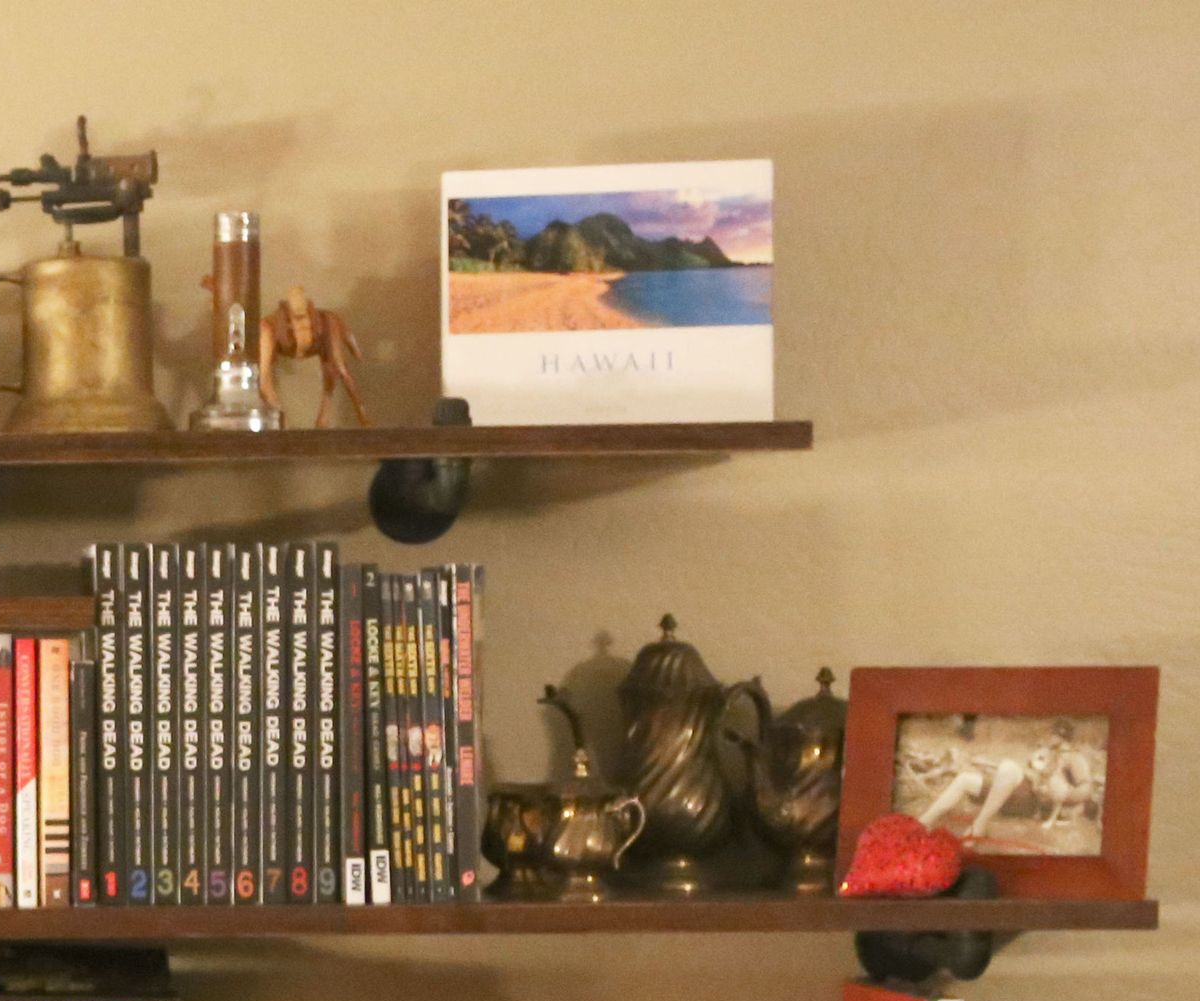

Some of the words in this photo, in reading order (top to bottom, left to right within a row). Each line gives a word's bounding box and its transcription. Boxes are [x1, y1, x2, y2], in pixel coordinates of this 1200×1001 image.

[541, 351, 674, 375] HAWAII
[102, 589, 115, 625] THE
[129, 590, 142, 627] THE
[157, 589, 171, 627] THE
[184, 589, 198, 626] THE
[210, 589, 224, 626] THE
[238, 591, 252, 628] THE
[266, 585, 280, 622] THE
[293, 588, 307, 625] THE
[320, 589, 334, 625] THE
[350, 619, 361, 664] LOCKE
[366, 618, 378, 664] LOCKE
[102, 632, 116, 713] WALKING
[129, 634, 143, 714] WALKING
[157, 633, 172, 713] WALKING
[184, 632, 198, 713] WALKING
[210, 632, 224, 713] WALKING
[238, 634, 252, 715] WALKING
[266, 628, 280, 710] WALKING
[293, 631, 307, 712] WALKING
[320, 631, 334, 712] WALKING
[350, 682, 361, 708] KEY
[368, 681, 380, 707] KEY
[20, 655, 32, 779] CONVERSATIONALLY
[102, 719, 116, 770] DEAD
[129, 720, 144, 771] DEAD
[158, 719, 172, 771] DEAD
[184, 719, 199, 770] DEAD
[210, 719, 225, 770] DEAD
[238, 721, 252, 771] DEAD
[266, 715, 280, 767] DEAD
[293, 717, 307, 769] DEAD
[320, 718, 334, 769] DEAD
[104, 871, 117, 897] 1
[131, 870, 147, 898] 2
[157, 869, 174, 895] 3
[184, 869, 201, 896] 4
[210, 870, 227, 897] 5
[237, 870, 255, 898] 6
[267, 868, 282, 893] 7
[291, 866, 309, 896] 8
[319, 868, 336, 896] 9
[351, 864, 361, 891] IDW
[376, 855, 387, 884] IDW
